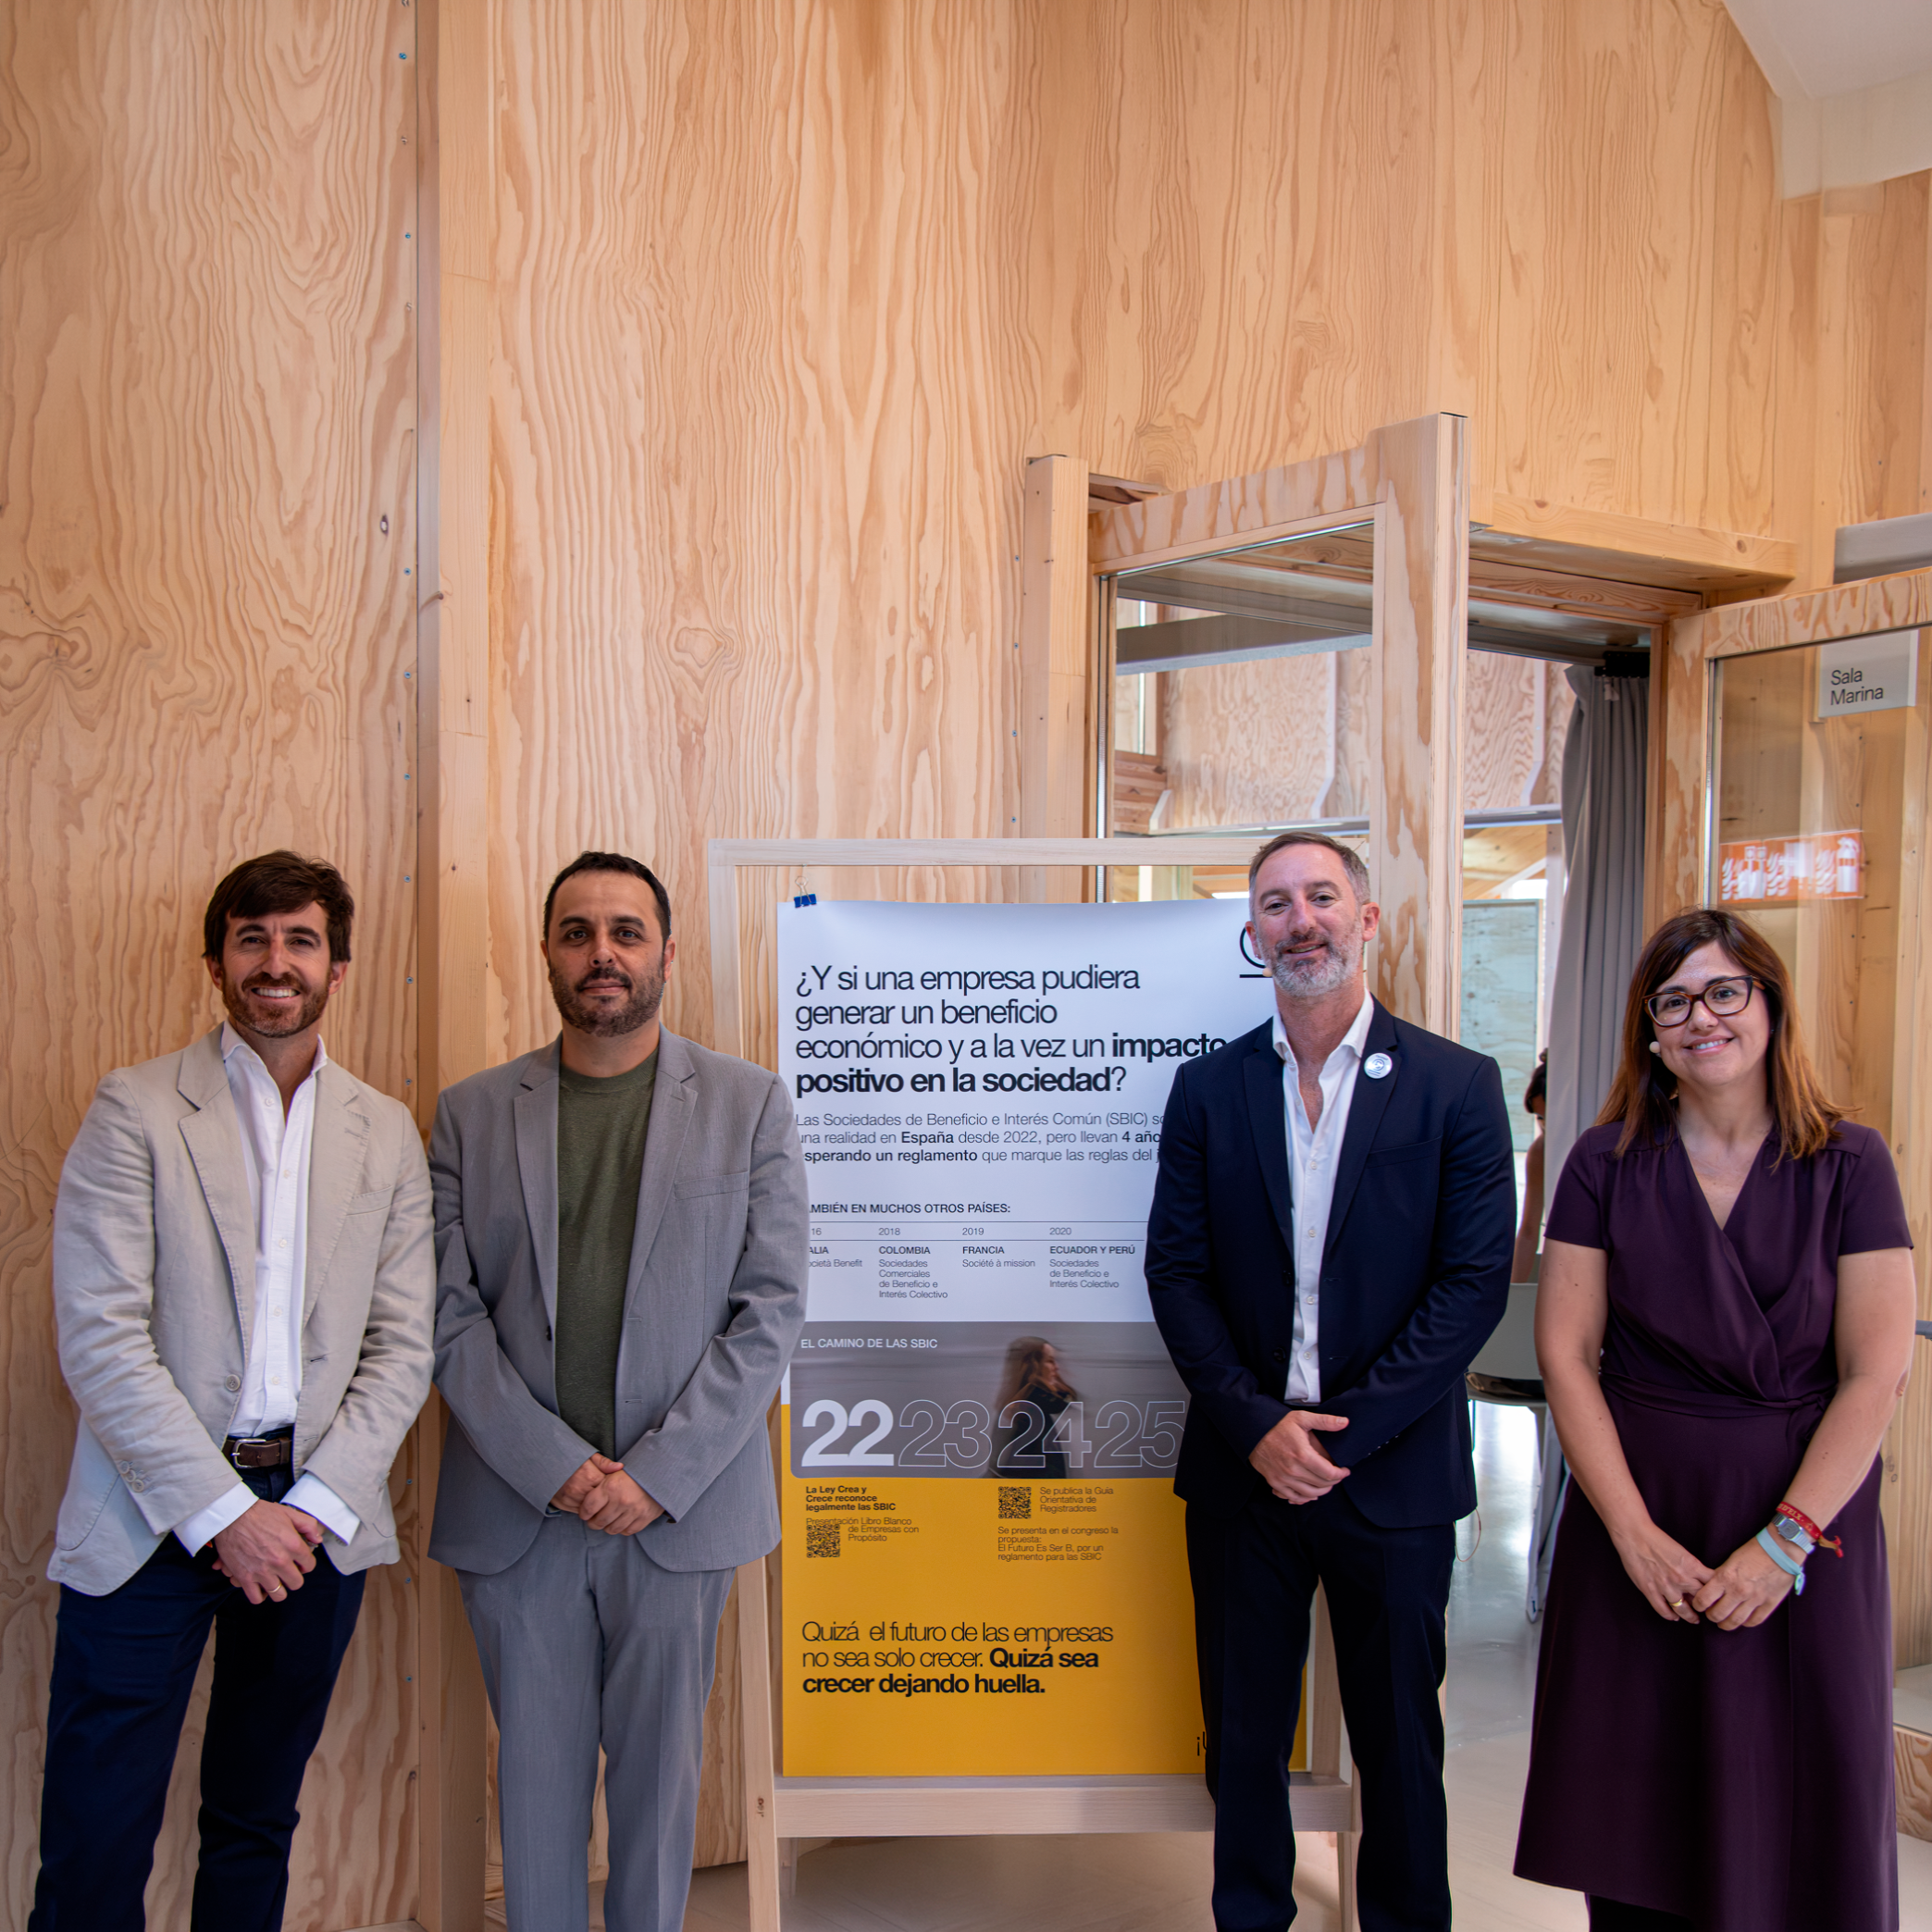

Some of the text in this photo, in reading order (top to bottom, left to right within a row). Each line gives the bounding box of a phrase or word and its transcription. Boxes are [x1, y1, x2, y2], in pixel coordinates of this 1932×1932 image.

[1831, 668, 1863, 686] Sala
[1831, 687, 1884, 705] Marina
[797, 964, 1140, 997] ¿Y si una empresa pudiera
[796, 998, 1058, 1031] generar un beneficio
[796, 1032, 942, 1059] económico
[948, 1040, 964, 1064] y
[971, 1039, 987, 1058] a
[995, 1033, 1015, 1058] la
[1021, 1039, 1066, 1058] vez
[1073, 1039, 1105, 1058] un
[797, 1066, 1126, 1098] positivo en la sociedad?
[796, 1112, 1164, 1127] Las Sociedades de Beneficio e Interés Común (SBIC) so
[824, 1132, 877, 1144] realidad
[880, 1134, 897, 1144] en
[901, 1132, 954, 1146] España
[959, 1132, 999, 1144] desde
[1004, 1131, 1042, 1145] 2022,
[1046, 1133, 1077, 1146] pero
[1081, 1131, 1118, 1143] llevan
[1121, 1131, 1131, 1142] 4
[1135, 1131, 1161, 1143] año
[805, 1149, 872, 1164] sperando
[876, 1153, 893, 1161] un
[898, 1149, 977, 1164] reglamento
[983, 1152, 1007, 1164] que
[1012, 1151, 1062, 1163] marque
[1066, 1149, 1084, 1160] las
[1089, 1149, 1129, 1164] reglas
[1133, 1149, 1152, 1160] del
[810, 1202, 1010, 1213] MBIÉN EN MUCHOS OTROS PAÍSES:
[879, 1228, 901, 1236] 2018
[1049, 1227, 1071, 1235] 2020
[879, 1246, 931, 1255] COLOMBIA
[1109, 1245, 1135, 1255] PERÚ
[809, 1259, 862, 1268] ocietà Benefit
[879, 1259, 928, 1268] Sociedades
[962, 1259, 1035, 1268] Société à mission
[1049, 1259, 1099, 1268] Sociedades
[879, 1269, 931, 1278] Comerciales
[1063, 1269, 1102, 1278] Beneficio
[892, 1280, 931, 1288] Beneficio
[1081, 1280, 1120, 1288] Colectivo
[910, 1290, 947, 1298] Colectivo
[801, 1338, 937, 1348] EL CAMINO DE LAS SBIC
[801, 1399, 1185, 1468] 22 23 24 25
[820, 1486, 836, 1494] Ley
[838, 1485, 859, 1493] Crea
[1040, 1487, 1051, 1495] Se
[1053, 1487, 1083, 1495] publica
[1040, 1495, 1084, 1504] Orientativa
[806, 1504, 856, 1512] legalmente
[1040, 1505, 1097, 1514] Registradores
[861, 1525, 901, 1534] Empresas
[1011, 1527, 1047, 1535] presenta
[1071, 1528, 1109, 1536] congreso
[998, 1536, 1042, 1544] propuesta:
[998, 1553, 1044, 1562] reglamento
[802, 1621, 1114, 1648] Quizá el futuro de las empresas
[803, 1645, 1098, 1668] no sea solo crecer. Quizá sea
[803, 1673, 1046, 1697] crecer dejando huella.
